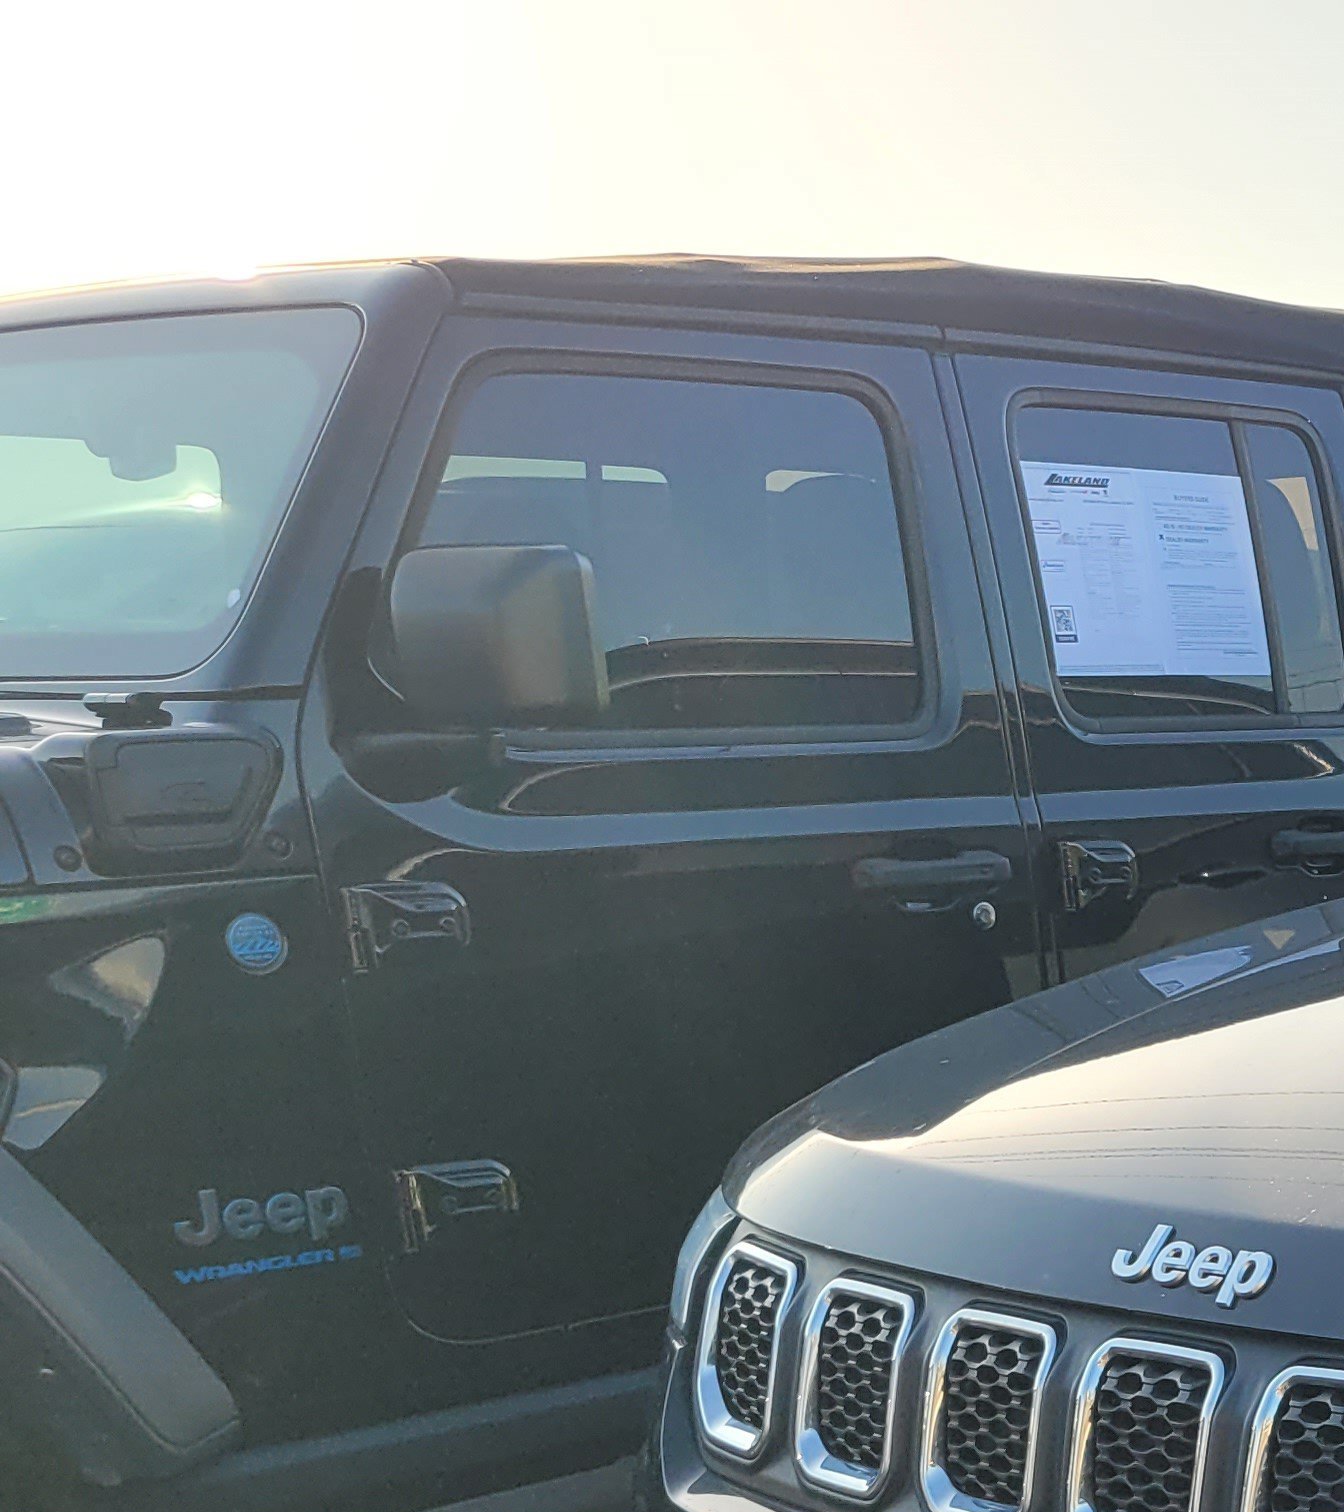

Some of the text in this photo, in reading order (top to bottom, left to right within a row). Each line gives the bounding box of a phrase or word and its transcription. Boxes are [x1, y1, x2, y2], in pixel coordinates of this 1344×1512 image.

[1043, 473, 1110, 488] LAKELAND
[174, 1186, 348, 1246] Jeep
[173, 1248, 335, 1285] WRANGLER
[1111, 1223, 1276, 1309] Jeep
